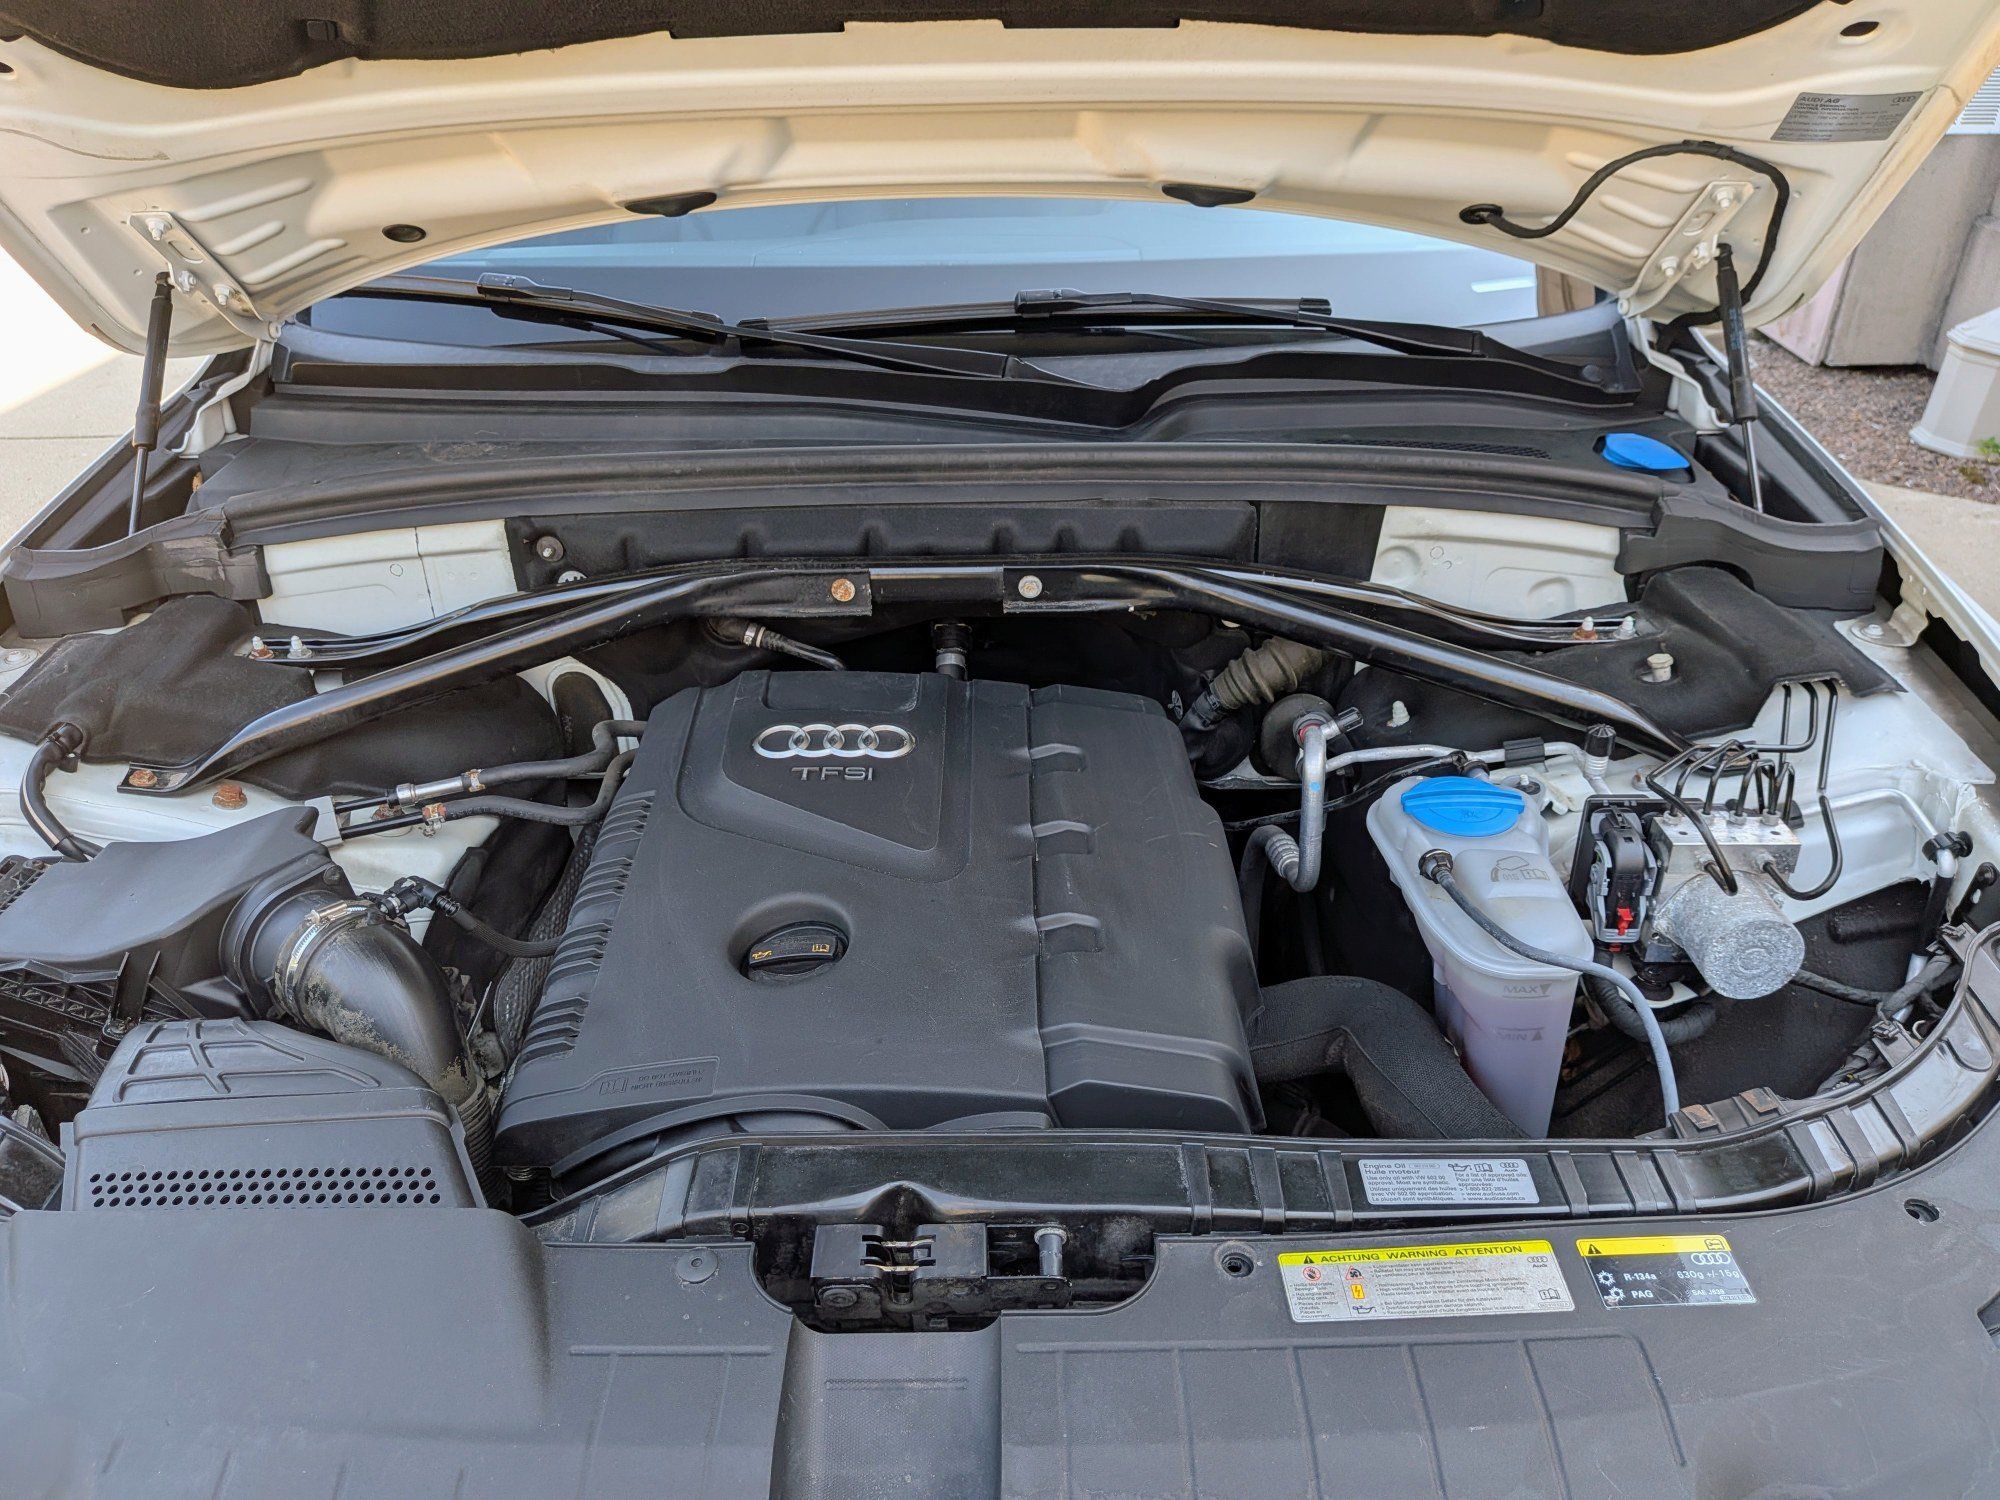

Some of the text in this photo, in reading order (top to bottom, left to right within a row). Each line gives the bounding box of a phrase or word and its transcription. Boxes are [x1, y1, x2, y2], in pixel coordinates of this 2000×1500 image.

[791, 766, 873, 781] TFSI
[1504, 984, 1538, 994] MAX
[1499, 1032, 1528, 1041] MIN
[1321, 1246, 1522, 1262] ACHTUNG WARNING ATTENTION
[1622, 1272, 1658, 1282] R-134a
[1676, 1270, 1704, 1280] 630g
[1630, 1290, 1654, 1299] PAG
